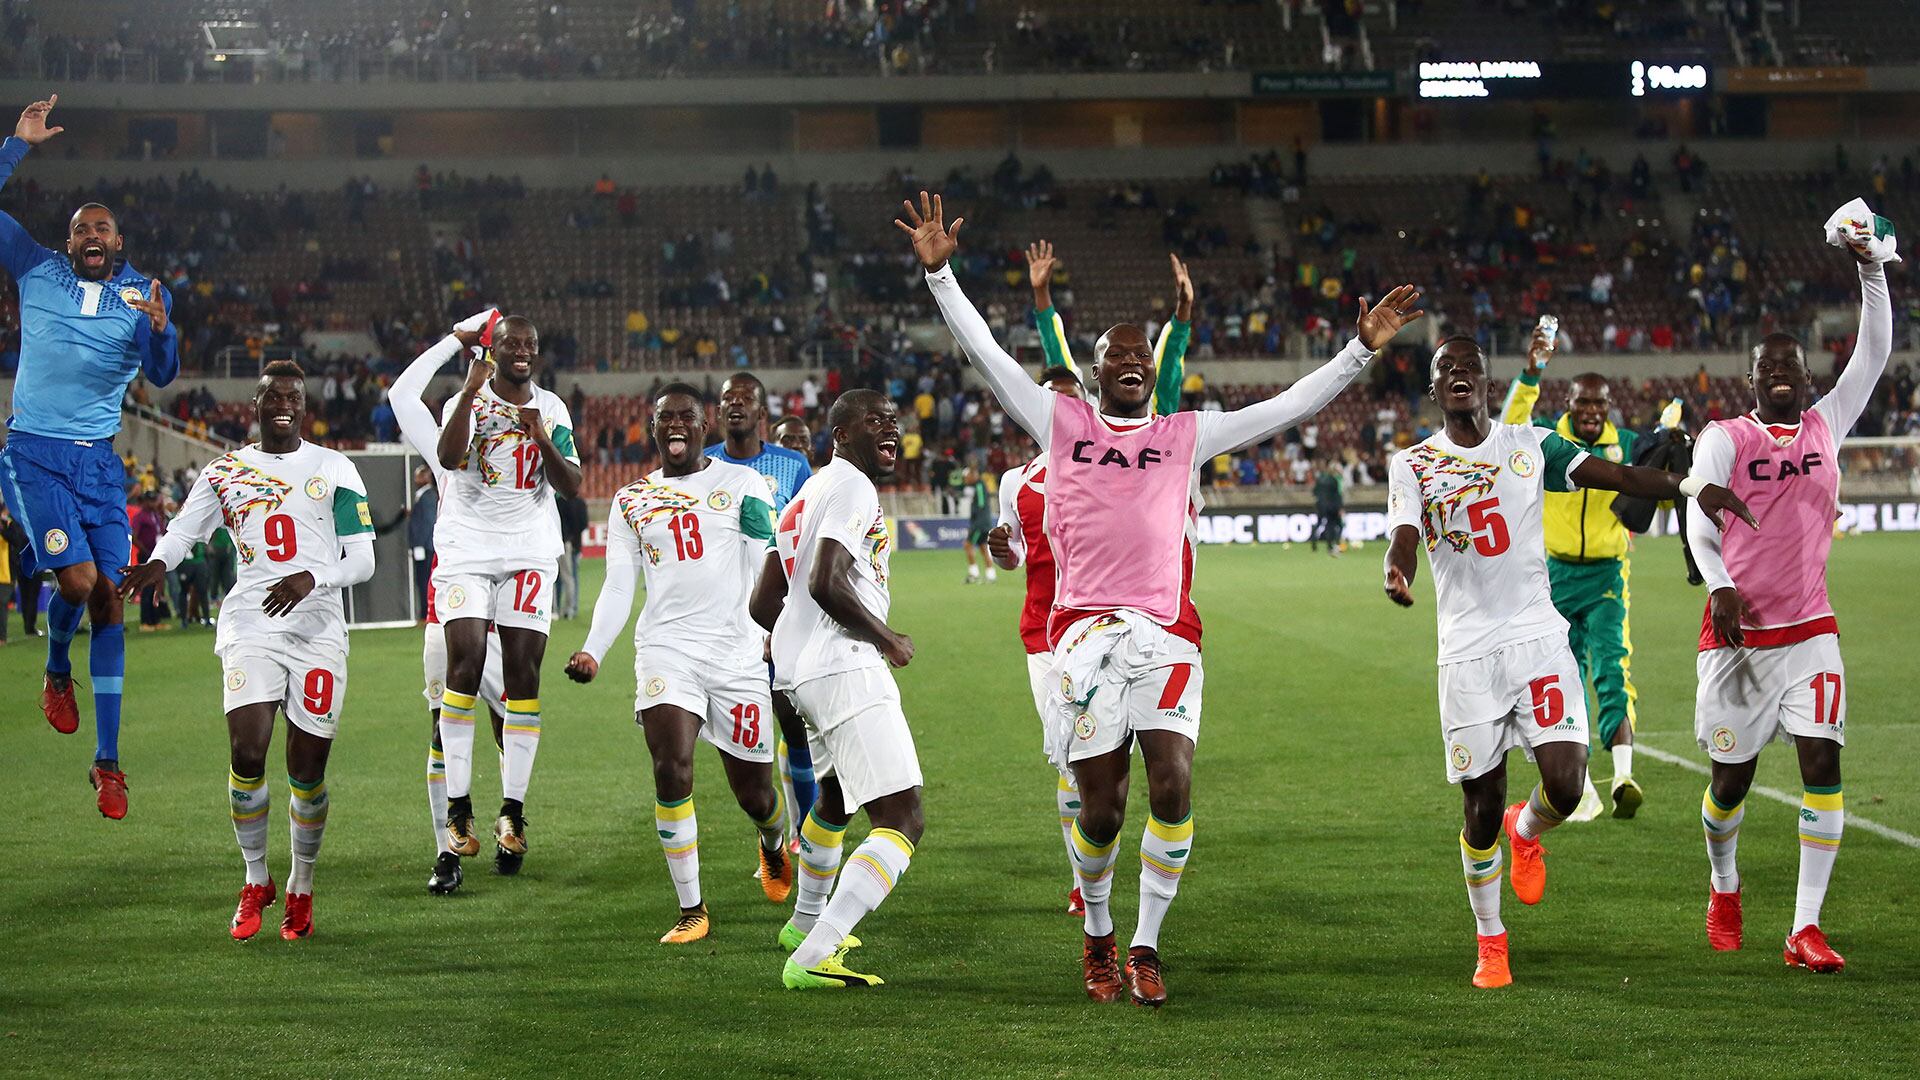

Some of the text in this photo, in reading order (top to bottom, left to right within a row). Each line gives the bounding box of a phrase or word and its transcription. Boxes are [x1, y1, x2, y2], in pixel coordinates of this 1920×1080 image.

[77, 281, 104, 317] 1
[512, 442, 540, 490] 12
[264, 513, 298, 562] 9
[668, 512, 704, 562] 13
[1199, 515, 1254, 543] ABC
[1466, 496, 1511, 557] 5
[513, 570, 541, 614] 12
[303, 668, 334, 715] 9
[1529, 674, 1564, 728] 5
[1809, 672, 1842, 725] 17
[730, 703, 760, 749] 13
